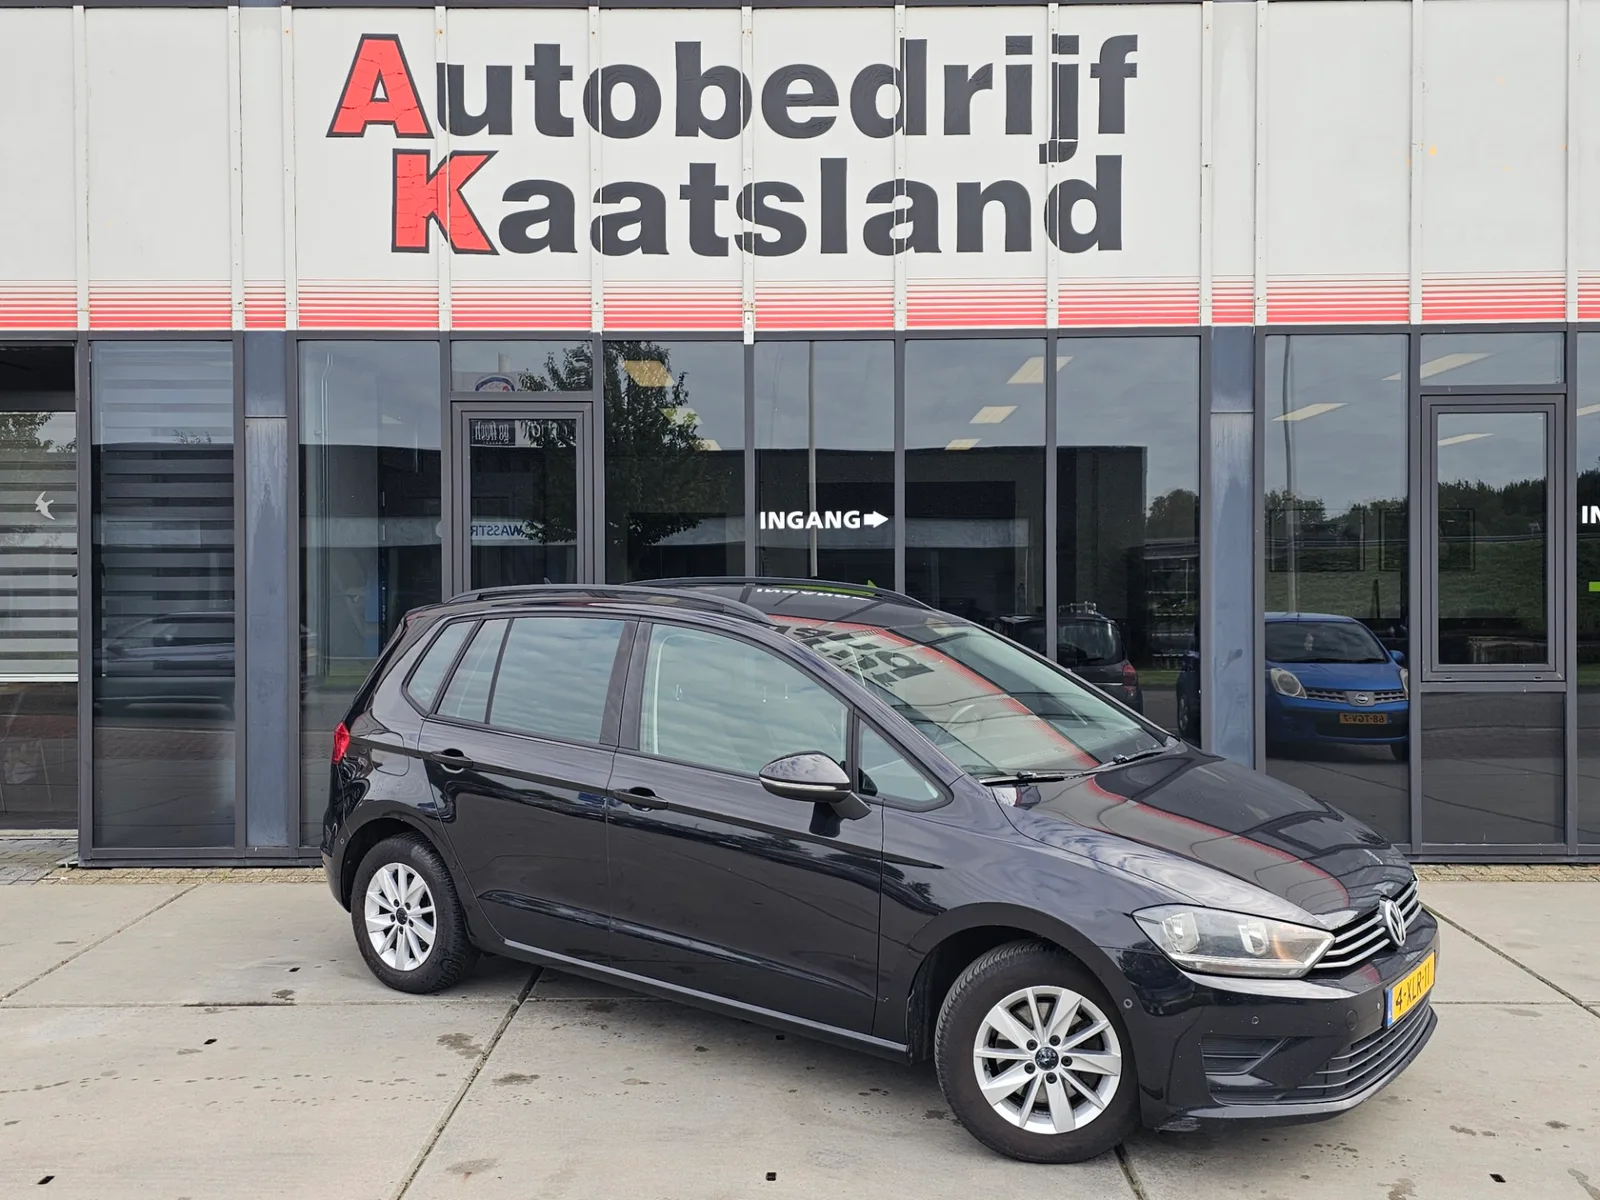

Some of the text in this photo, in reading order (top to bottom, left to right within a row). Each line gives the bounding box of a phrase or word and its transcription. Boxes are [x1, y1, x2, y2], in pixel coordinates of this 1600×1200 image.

[326, 33, 1138, 164] Autobedrijf
[391, 148, 1122, 257] Kaatsland
[760, 510, 861, 530] INGANG
[1395, 962, 1430, 1011] 4-XLR-11
